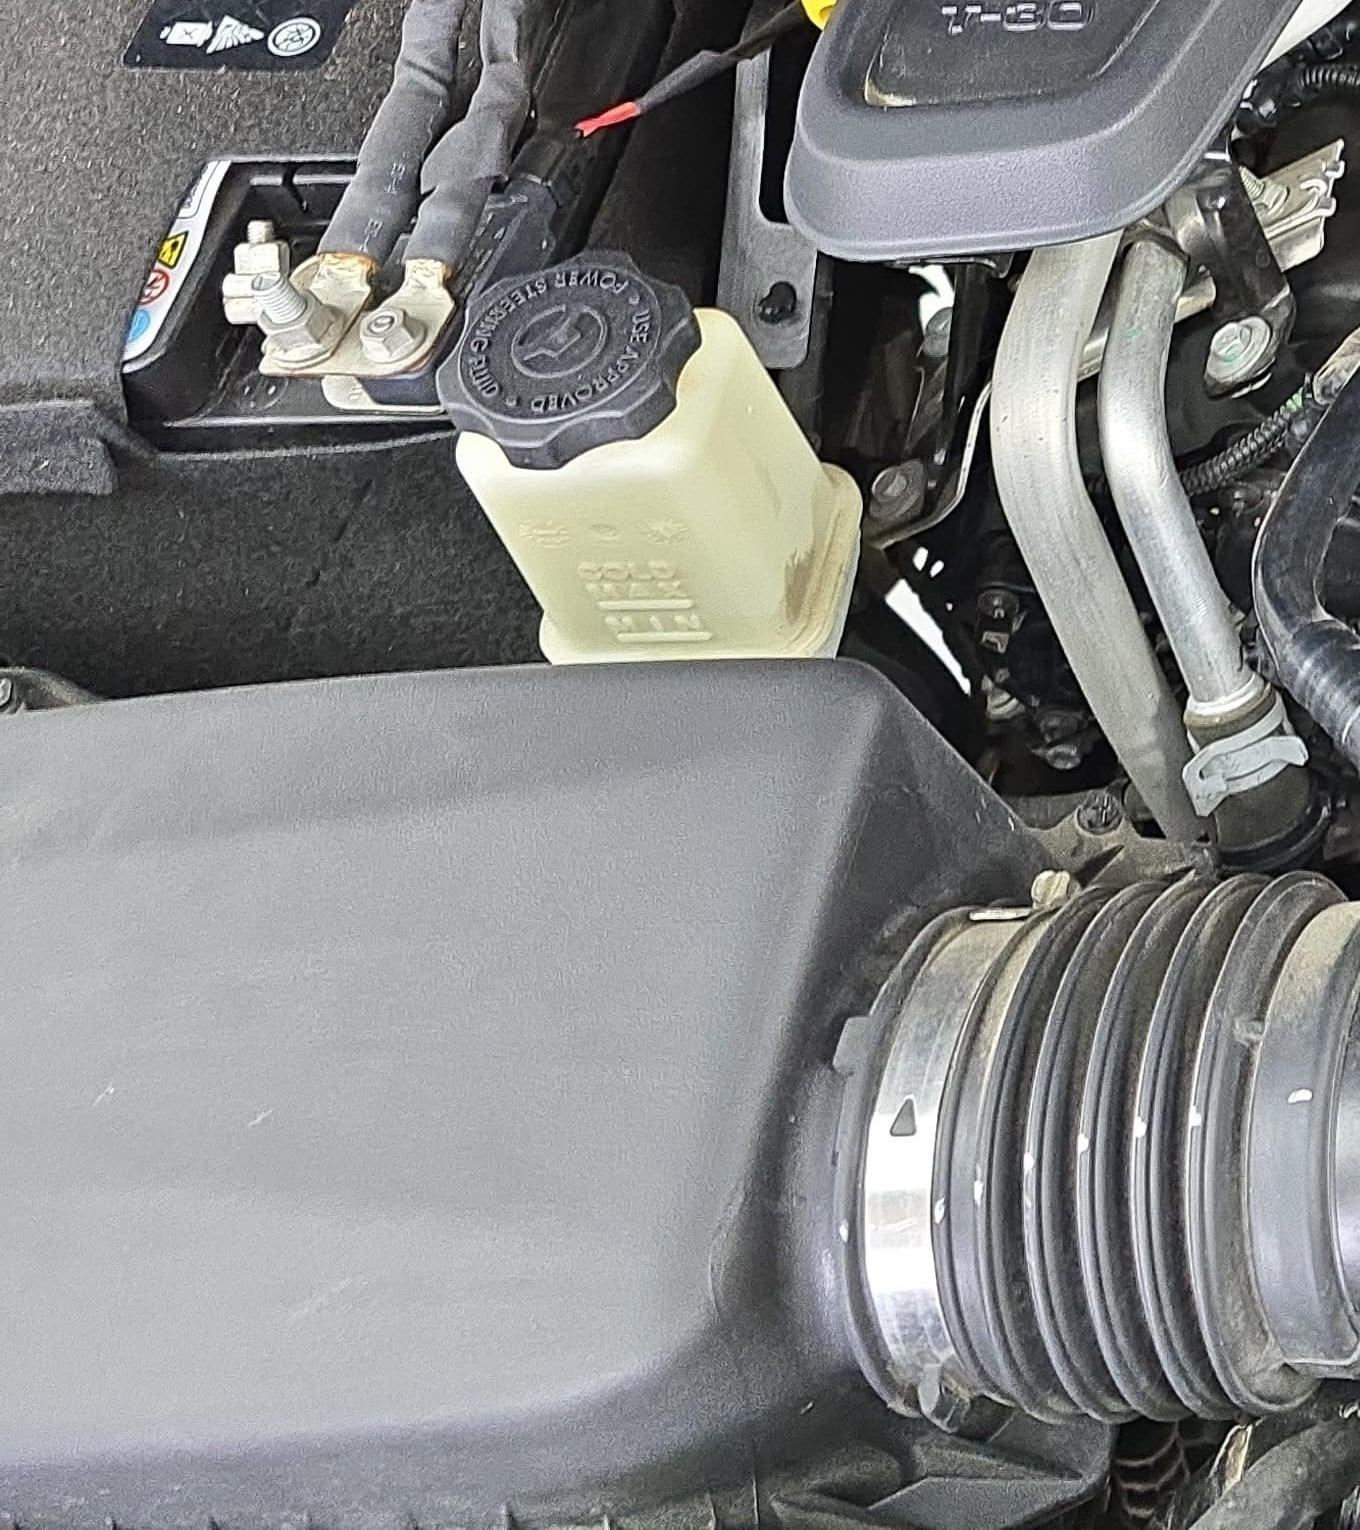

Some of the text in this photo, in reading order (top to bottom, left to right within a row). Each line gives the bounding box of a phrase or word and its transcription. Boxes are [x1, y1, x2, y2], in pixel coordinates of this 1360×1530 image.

[468, 278, 548, 351] STEERING
[530, 310, 651, 415] USE APPROVED
